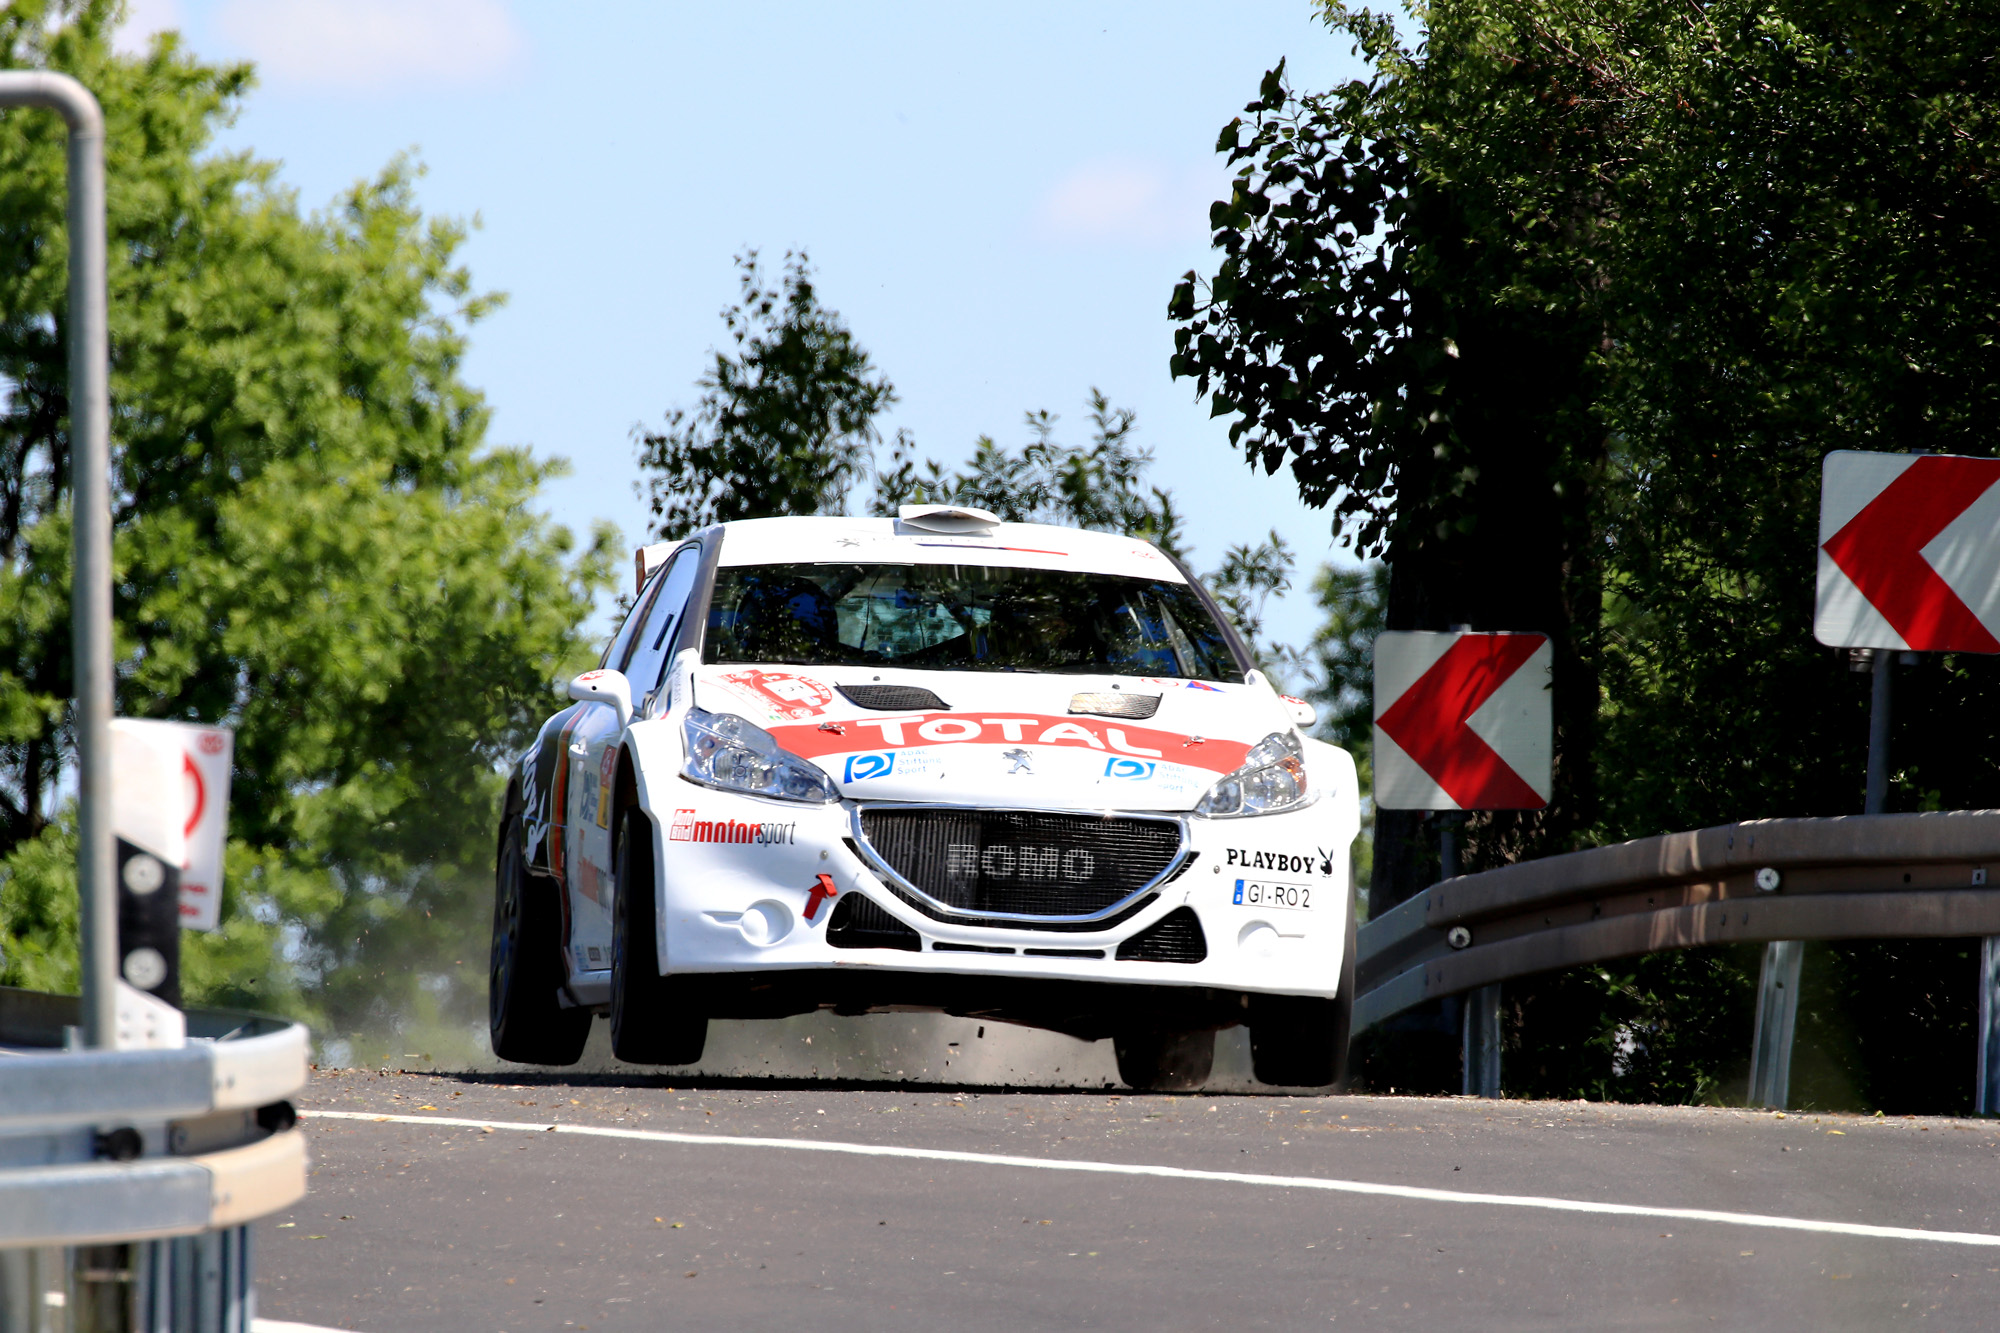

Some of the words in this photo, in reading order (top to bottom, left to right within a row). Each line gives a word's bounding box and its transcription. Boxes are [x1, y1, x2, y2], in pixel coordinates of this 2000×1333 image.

[856, 716, 1162, 757] TOTAL
[901, 748, 928, 756] ADAC
[899, 757, 942, 765] Stiftung
[897, 766, 926, 774] Sport
[947, 843, 1096, 881] ROMO
[1226, 848, 1315, 874] PLAYBOY
